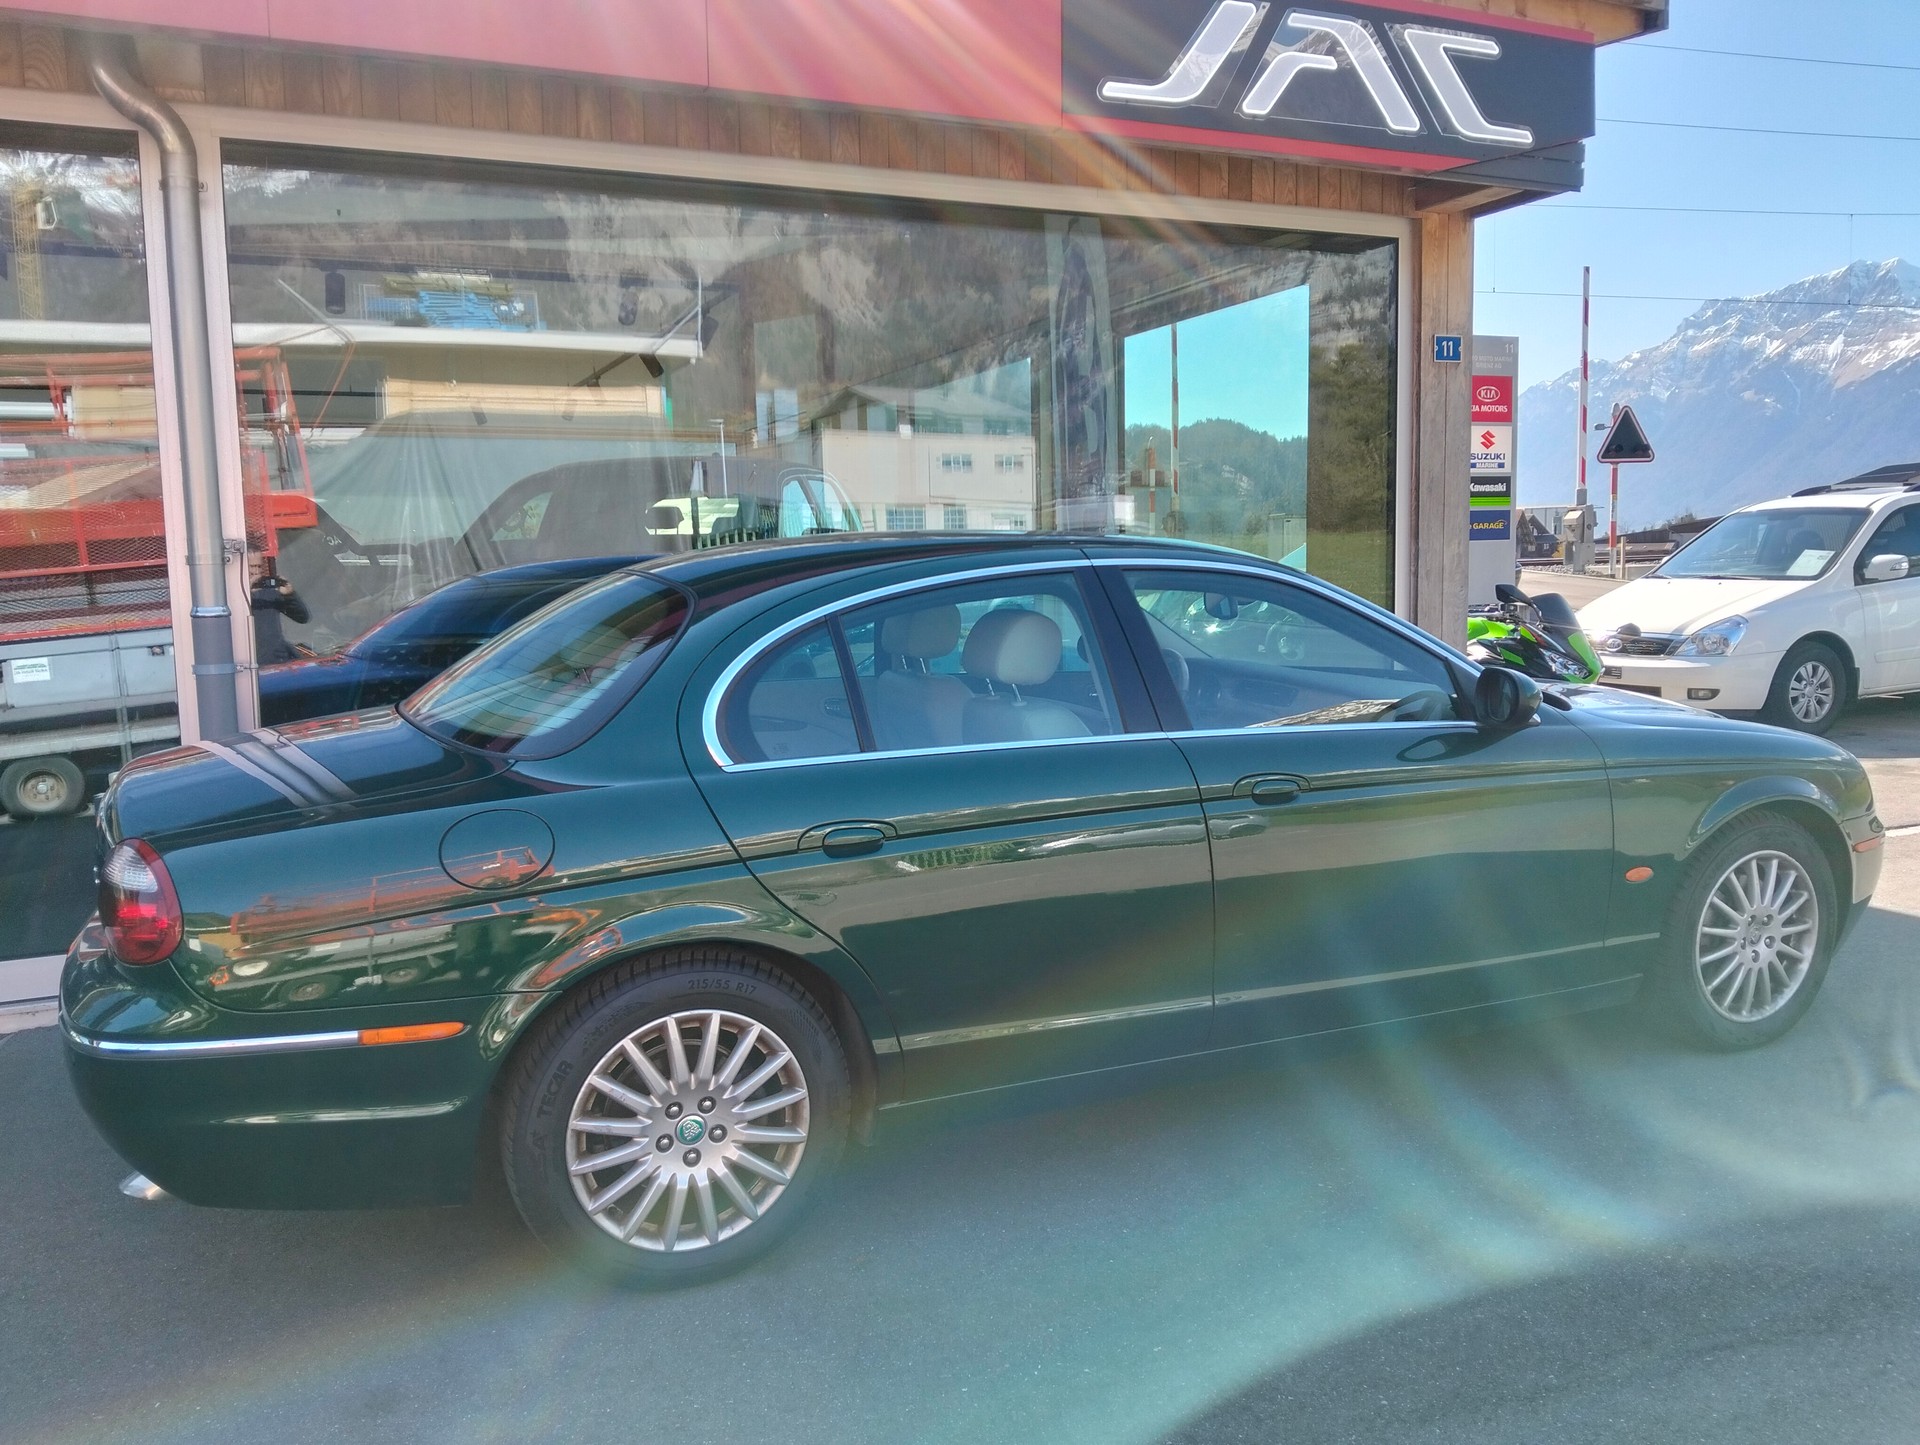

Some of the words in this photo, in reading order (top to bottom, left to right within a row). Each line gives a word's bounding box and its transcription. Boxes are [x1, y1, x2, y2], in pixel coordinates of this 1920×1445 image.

[1442, 340, 1453, 356] 11
[1505, 344, 1514, 353] 11
[1481, 389, 1496, 398] KIA
[1481, 405, 1508, 413] MOTORS
[687, 979, 731, 990] 215/55
[735, 982, 758, 995] R17
[536, 1060, 574, 1118] TECAR
